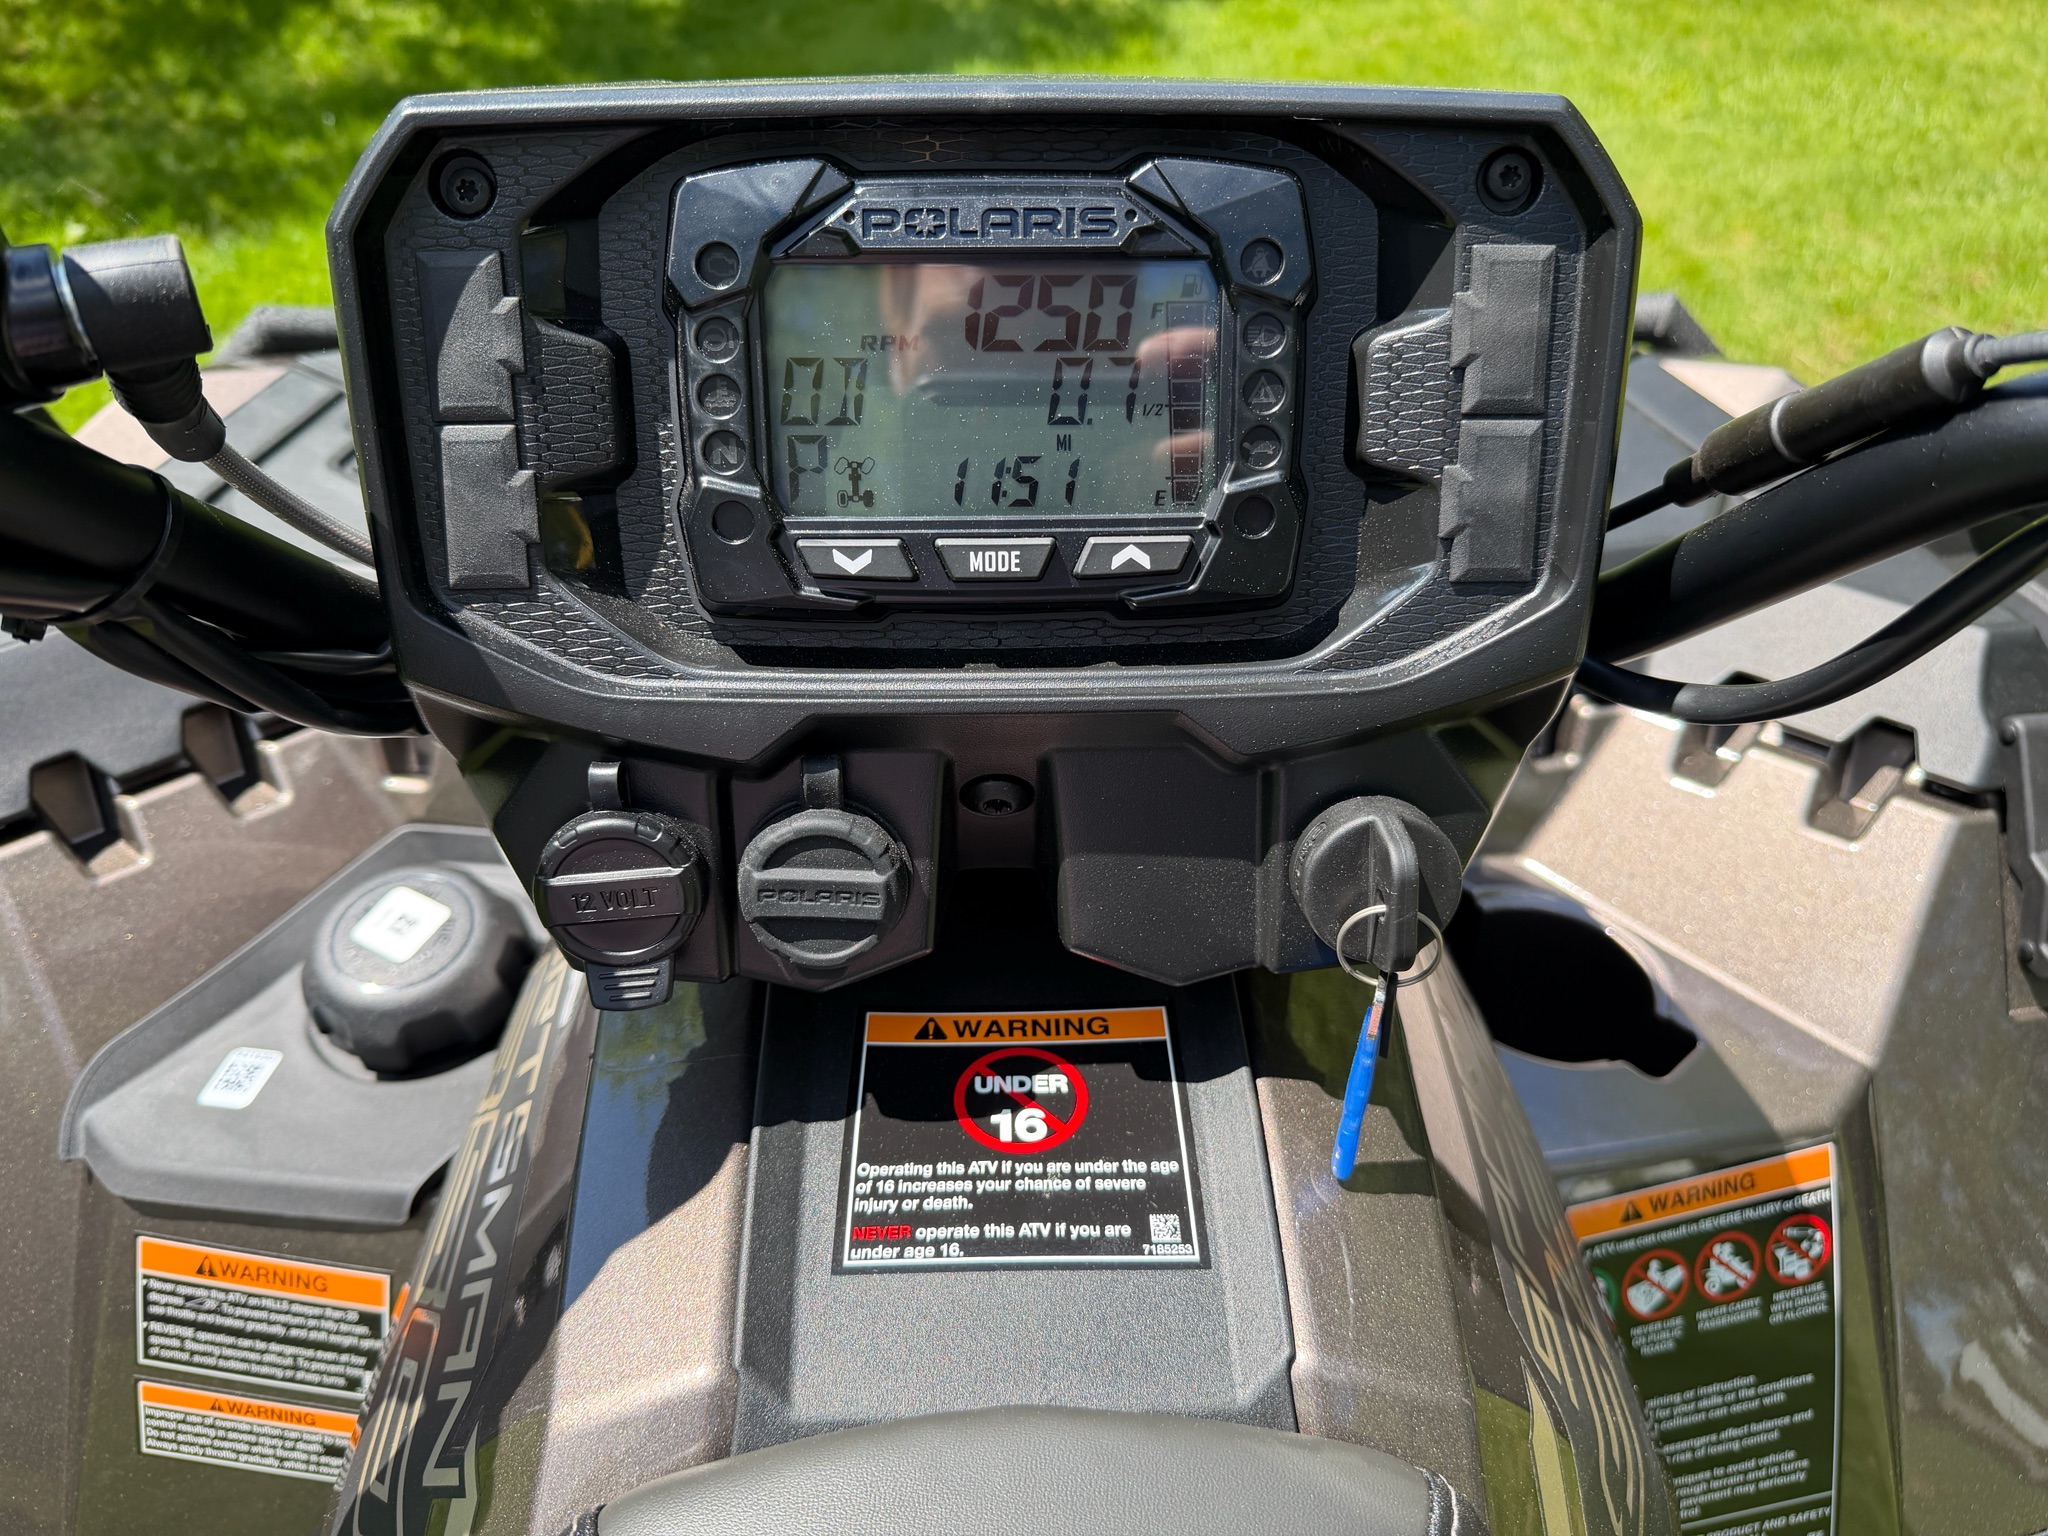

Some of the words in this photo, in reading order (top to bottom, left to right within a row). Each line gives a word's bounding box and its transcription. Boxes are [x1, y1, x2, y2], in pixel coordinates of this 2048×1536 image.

[862, 207, 1119, 239] POLARIS
[964, 274, 1138, 352] 1250
[860, 335, 920, 352] RPM
[1142, 403, 1164, 417] 1/2
[1056, 434, 1072, 452] MI
[954, 456, 1081, 507] 11:51
[1154, 490, 1167, 507] E
[969, 550, 1021, 573] MODE
[570, 892, 598, 914] 12
[599, 886, 659, 912] VOLT
[756, 887, 883, 909] POLARIS
[954, 1016, 1110, 1038] WARNING
[973, 1073, 1069, 1094] UNDER
[990, 1107, 1048, 1143] 16
[857, 1162, 933, 1179] Operating
[936, 1161, 965, 1175] this
[967, 1160, 998, 1175] ATV
[1001, 1160, 1013, 1174] if
[1014, 1162, 1043, 1177] you
[1046, 1161, 1072, 1174] are
[1075, 1160, 1120, 1174] under
[1121, 1159, 1147, 1173] the
[1150, 1160, 1180, 1176] age
[855, 1180, 873, 1194] of
[876, 1179, 895, 1194] 16
[897, 1178, 973, 1193] increases
[976, 1179, 1012, 1195] your
[1014, 1177, 1072, 1191] chance
[1075, 1176, 1092, 1191] of
[1095, 1178, 1147, 1191] severe
[1649, 1173, 1757, 1214] WARNING
[853, 1197, 899, 1215] injury
[901, 1198, 920, 1212] or
[922, 1195, 974, 1211] death.
[852, 1225, 912, 1241] NEVER
[915, 1224, 980, 1243] operate
[983, 1223, 1014, 1238] this
[1018, 1222, 1051, 1238] ATV
[1055, 1222, 1067, 1238] if
[1069, 1224, 1101, 1241] you
[1104, 1224, 1132, 1237] are
[850, 1244, 901, 1260] under
[903, 1246, 936, 1259] age
[939, 1242, 965, 1258] 16.
[1142, 1243, 1194, 1256] 7185253
[219, 1260, 328, 1293] WARNING
[226, 1400, 317, 1427] WARNING
[1788, 1505, 1832, 1525] SAFETY
